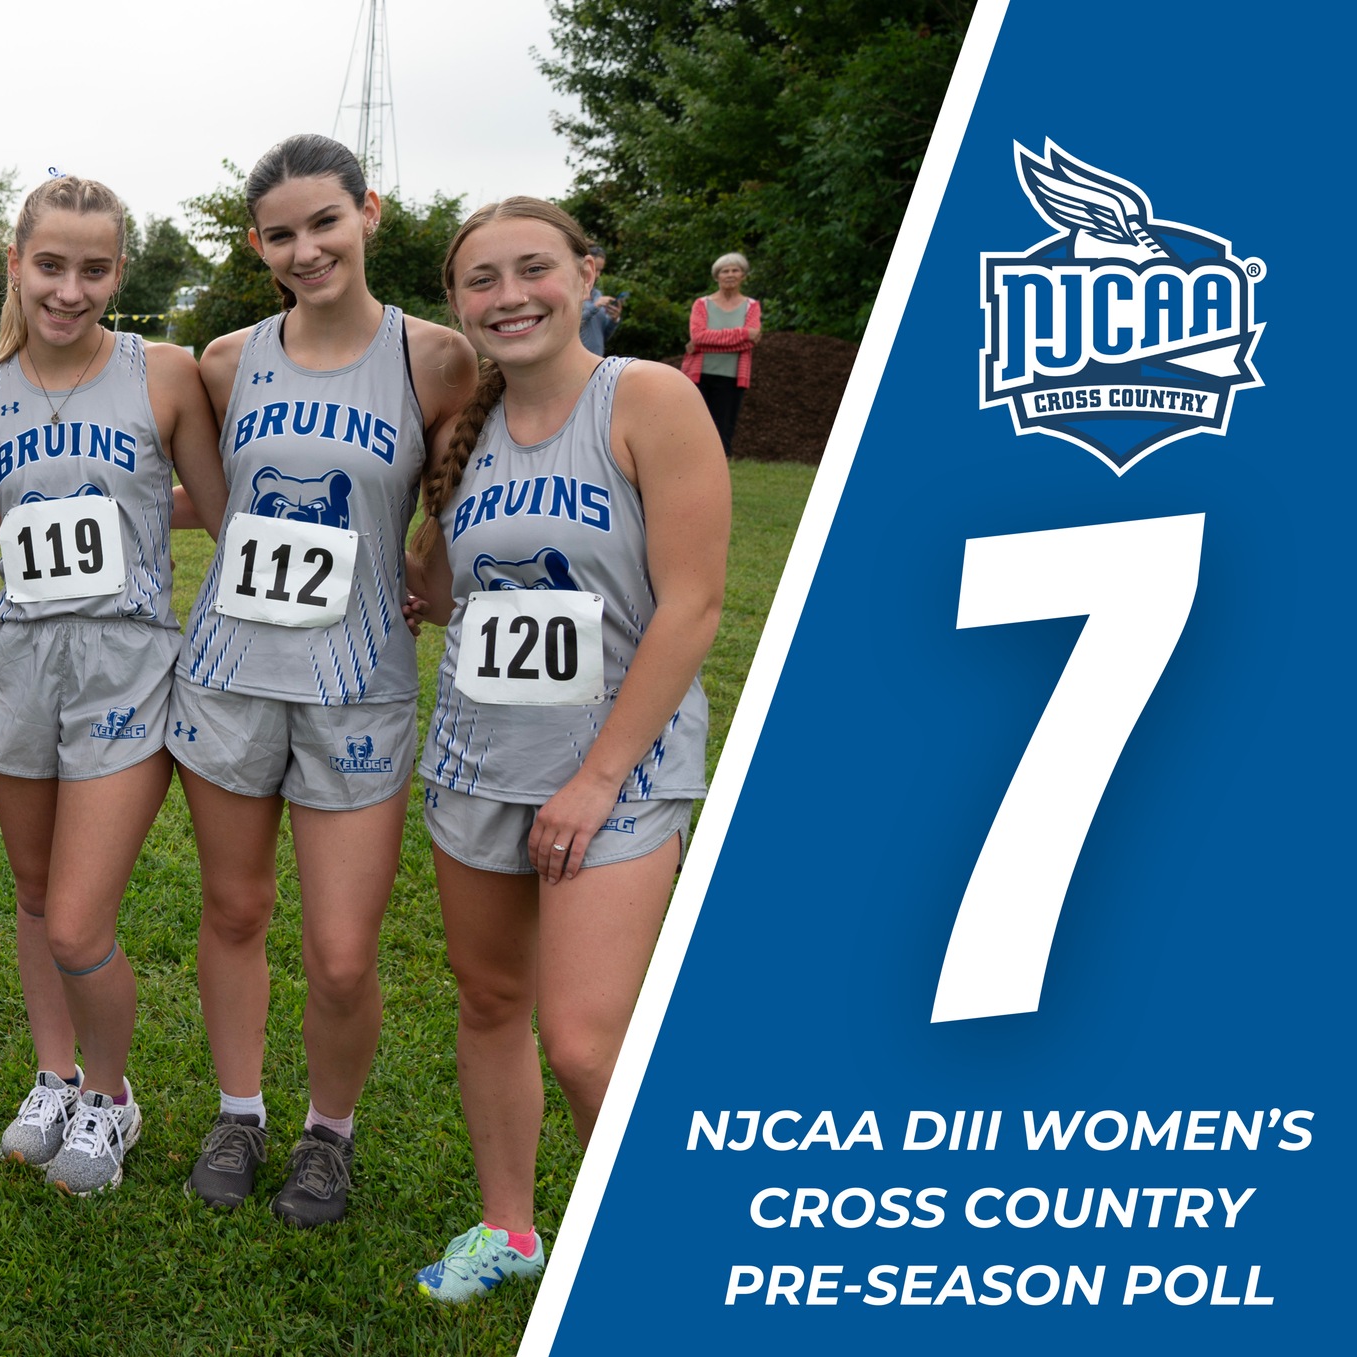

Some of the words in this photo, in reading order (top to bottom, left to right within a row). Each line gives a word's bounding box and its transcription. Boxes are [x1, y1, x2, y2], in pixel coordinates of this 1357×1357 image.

[232, 399, 400, 467] BRUINS
[449, 473, 614, 545] BRUINS
[16, 517, 105, 582] 119
[234, 538, 335, 609] 112
[476, 614, 579, 683] 120
[329, 756, 393, 773] KELLOGG
